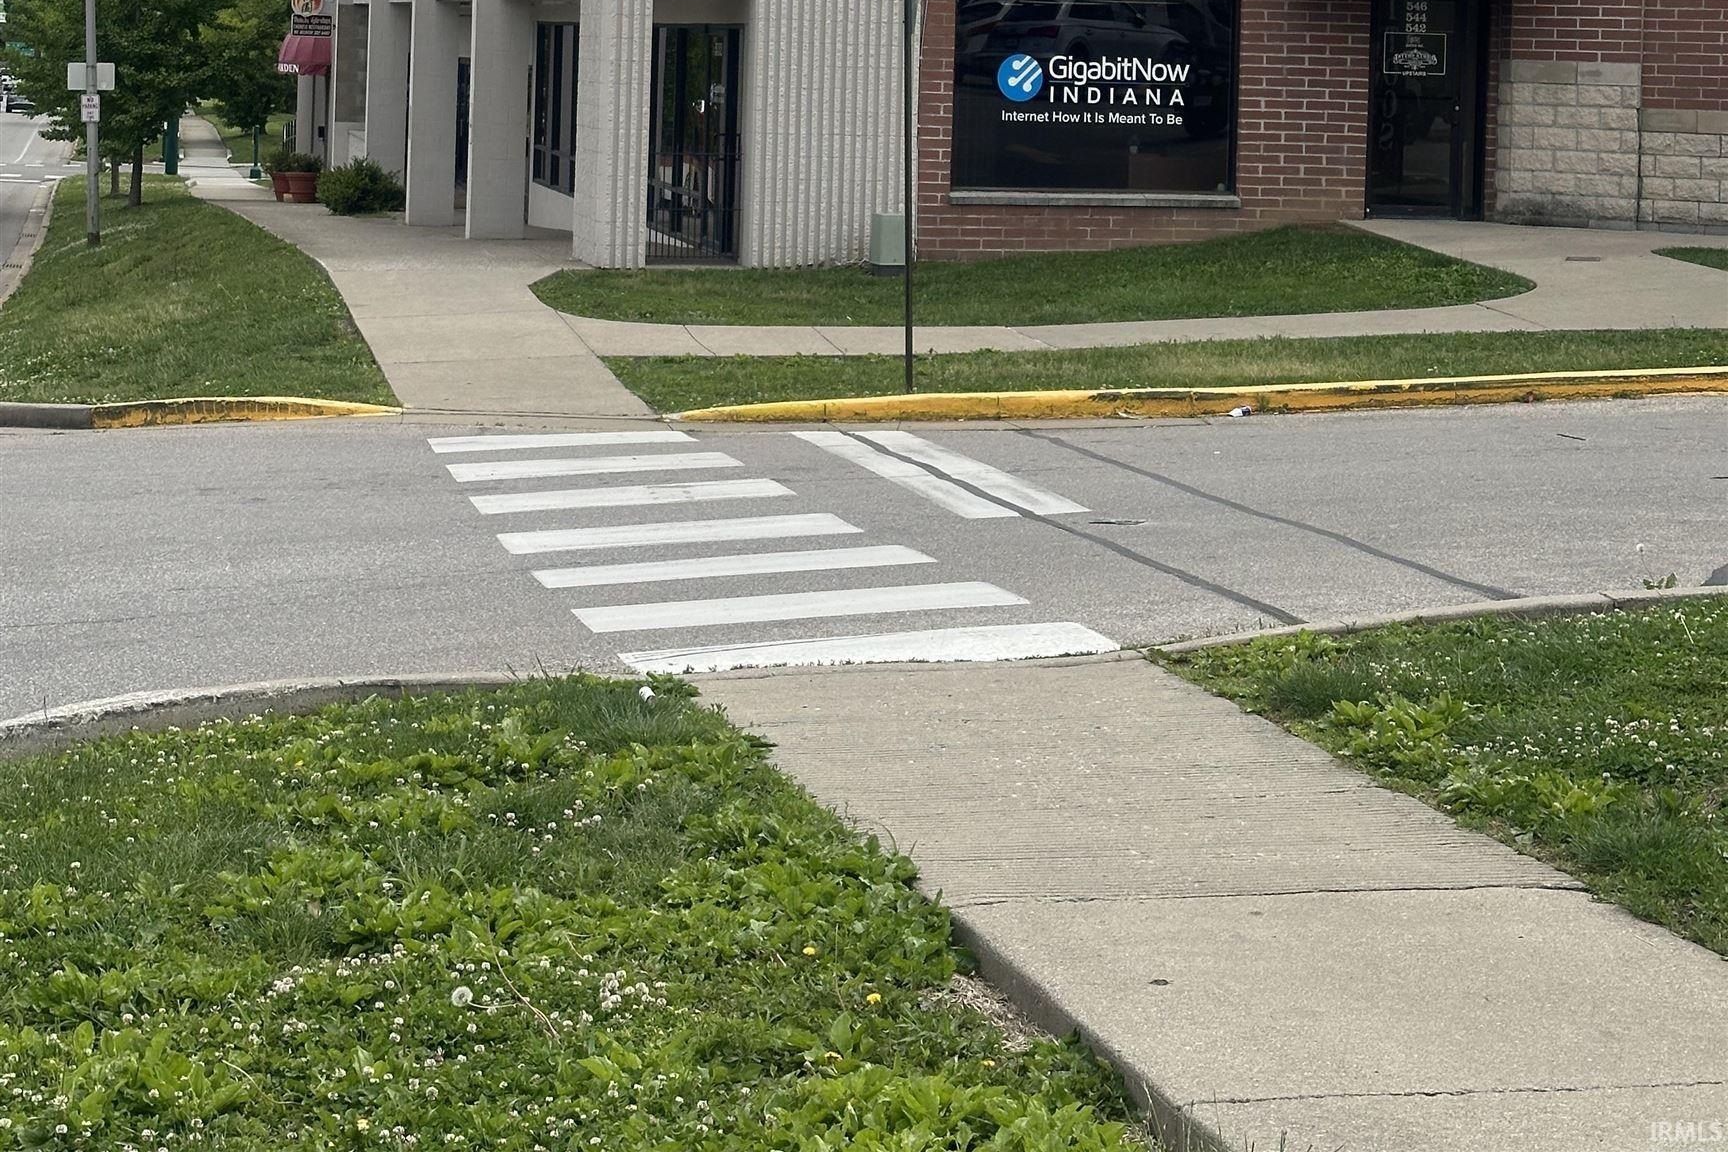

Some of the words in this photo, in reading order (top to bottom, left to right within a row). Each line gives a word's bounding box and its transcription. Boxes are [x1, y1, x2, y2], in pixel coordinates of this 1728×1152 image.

[1406, 1, 1427, 11] 546
[1405, 23, 1427, 33] 542
[1049, 55, 1190, 86] GigabitNow
[1049, 86, 1185, 106] INDIANA
[1001, 110, 1050, 123] Internet
[1052, 111, 1081, 123] How
[1083, 112, 1092, 123] It
[1094, 112, 1105, 124] Is
[1108, 112, 1147, 125] Meant
[1149, 113, 1164, 125] To
[1166, 113, 1184, 126] Be
